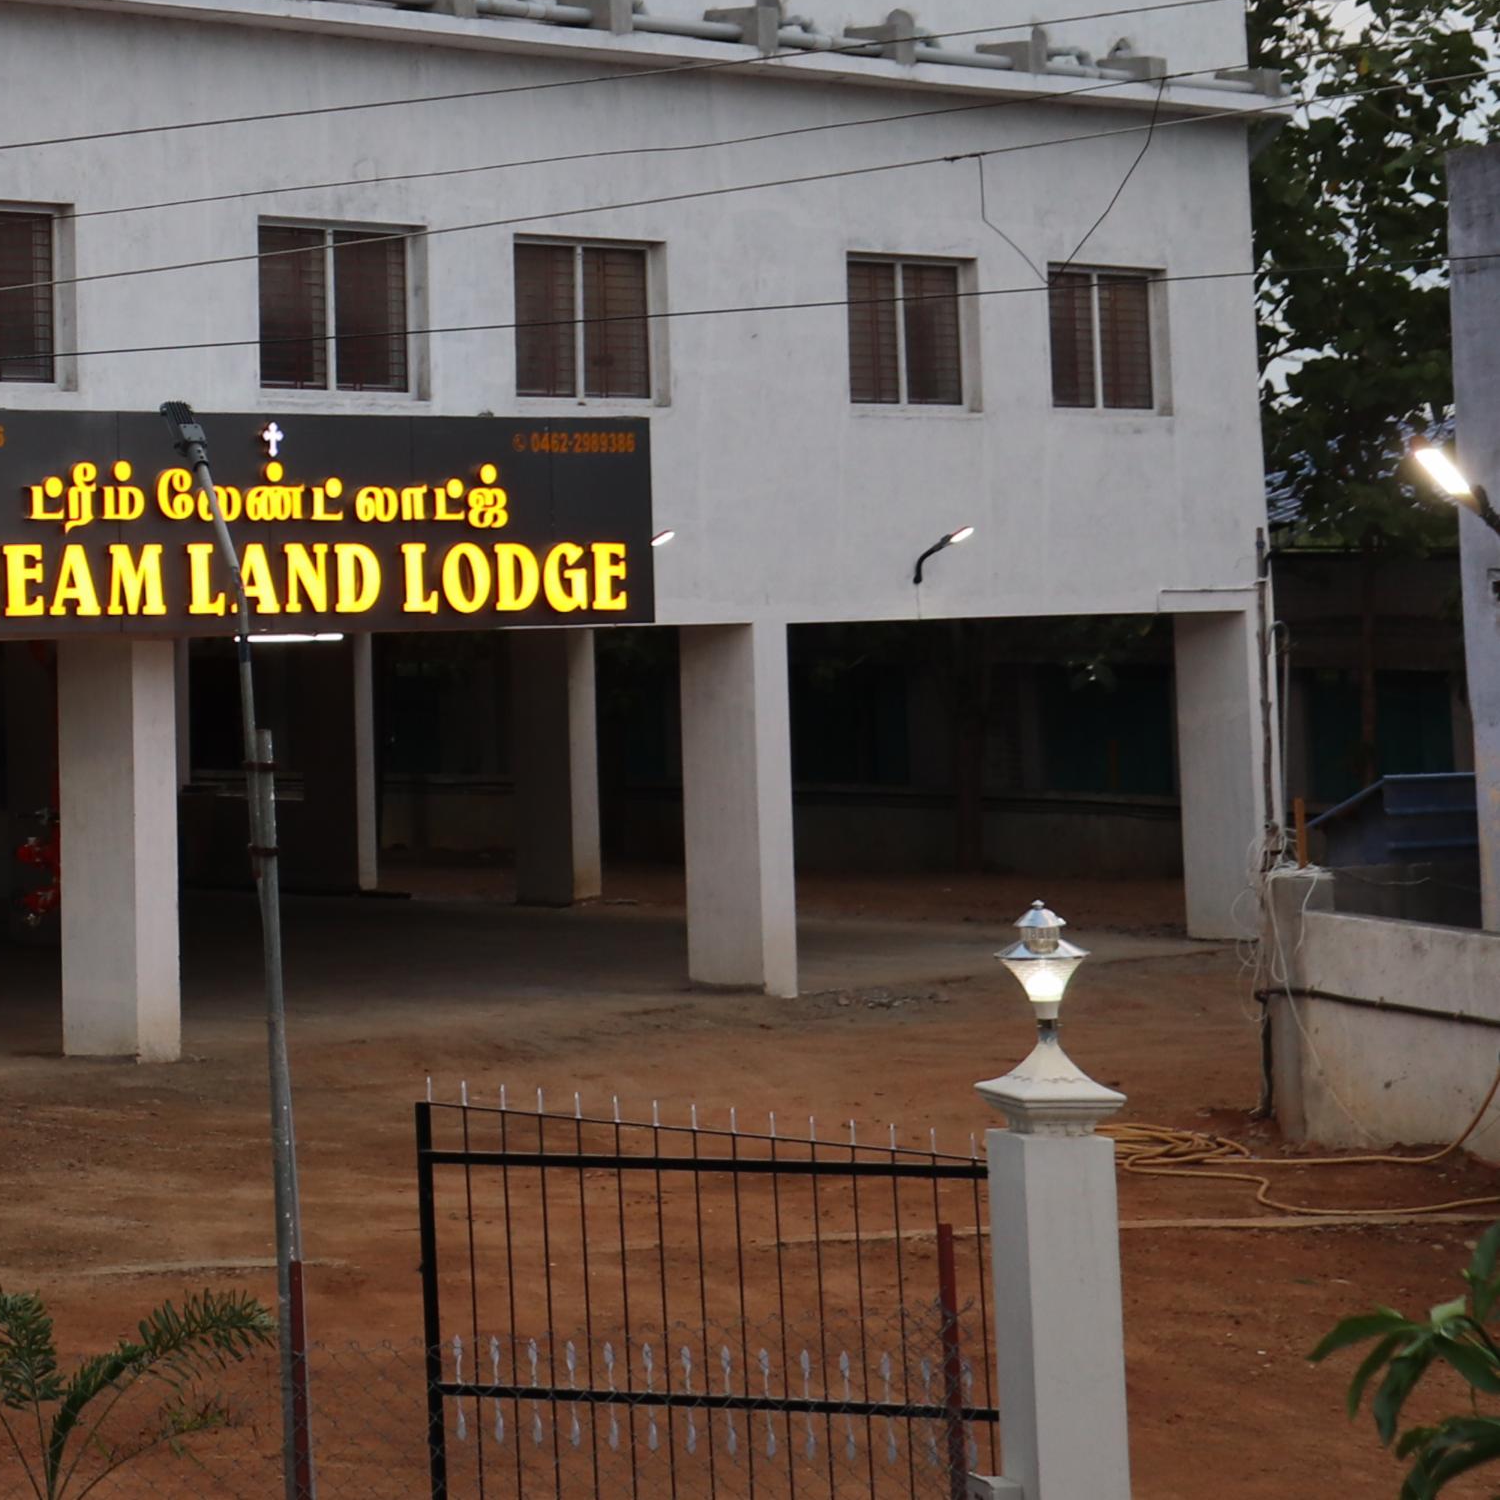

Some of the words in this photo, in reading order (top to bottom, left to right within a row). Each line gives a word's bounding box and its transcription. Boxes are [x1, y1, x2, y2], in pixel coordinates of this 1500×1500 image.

[29, 461, 146, 533] ட்ரீம்
[155, 461, 344, 522] லேண்ட்
[355, 463, 509, 528] லாட்ஜ்
[186, 542, 382, 617] LAND
[400, 541, 628, 614] LODGE
